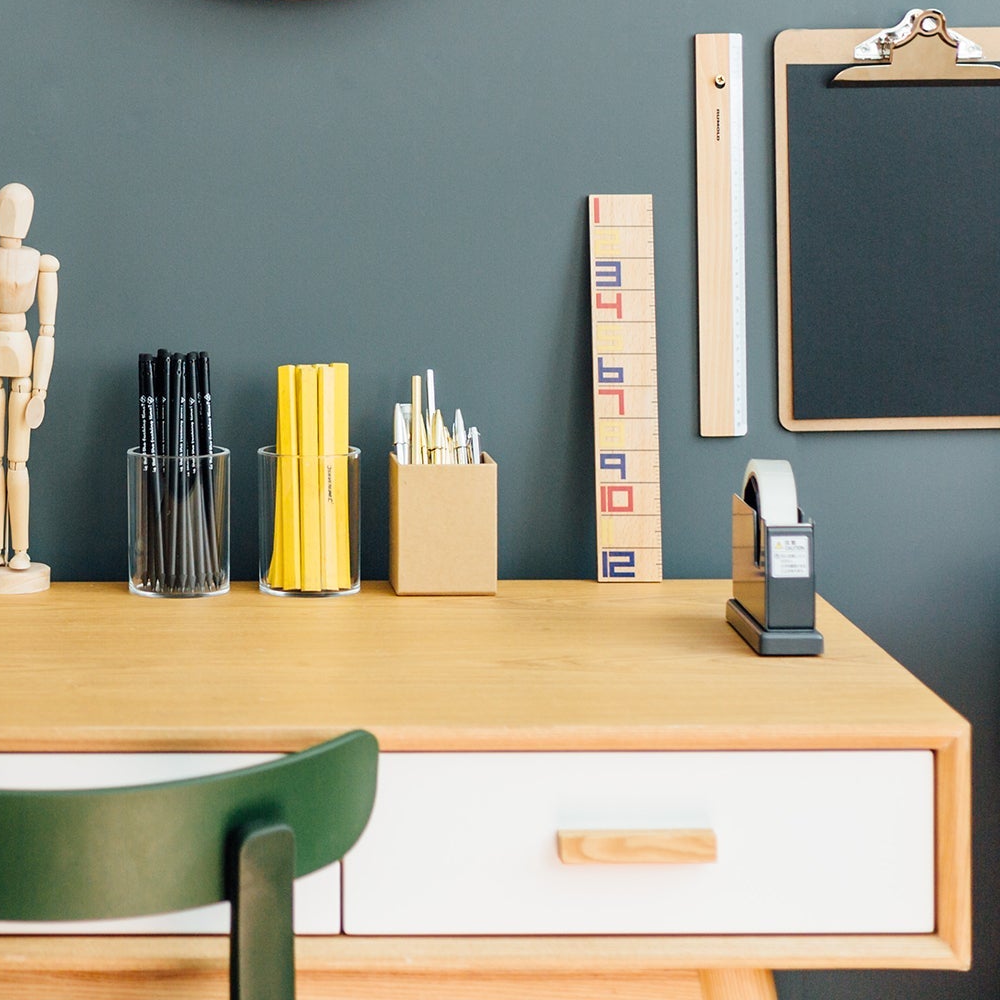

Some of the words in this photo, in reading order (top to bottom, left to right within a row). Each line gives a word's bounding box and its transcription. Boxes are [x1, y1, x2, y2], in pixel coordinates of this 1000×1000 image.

[594, 229, 620, 255] 2
[595, 261, 621, 287] 3
[596, 293, 622, 319] 4
[597, 325, 624, 351] 5
[597, 357, 624, 383] 6
[598, 389, 625, 415] 7
[599, 421, 626, 447] 8
[600, 453, 626, 480] 9
[600, 486, 634, 512] 10
[602, 551, 635, 577] 12
